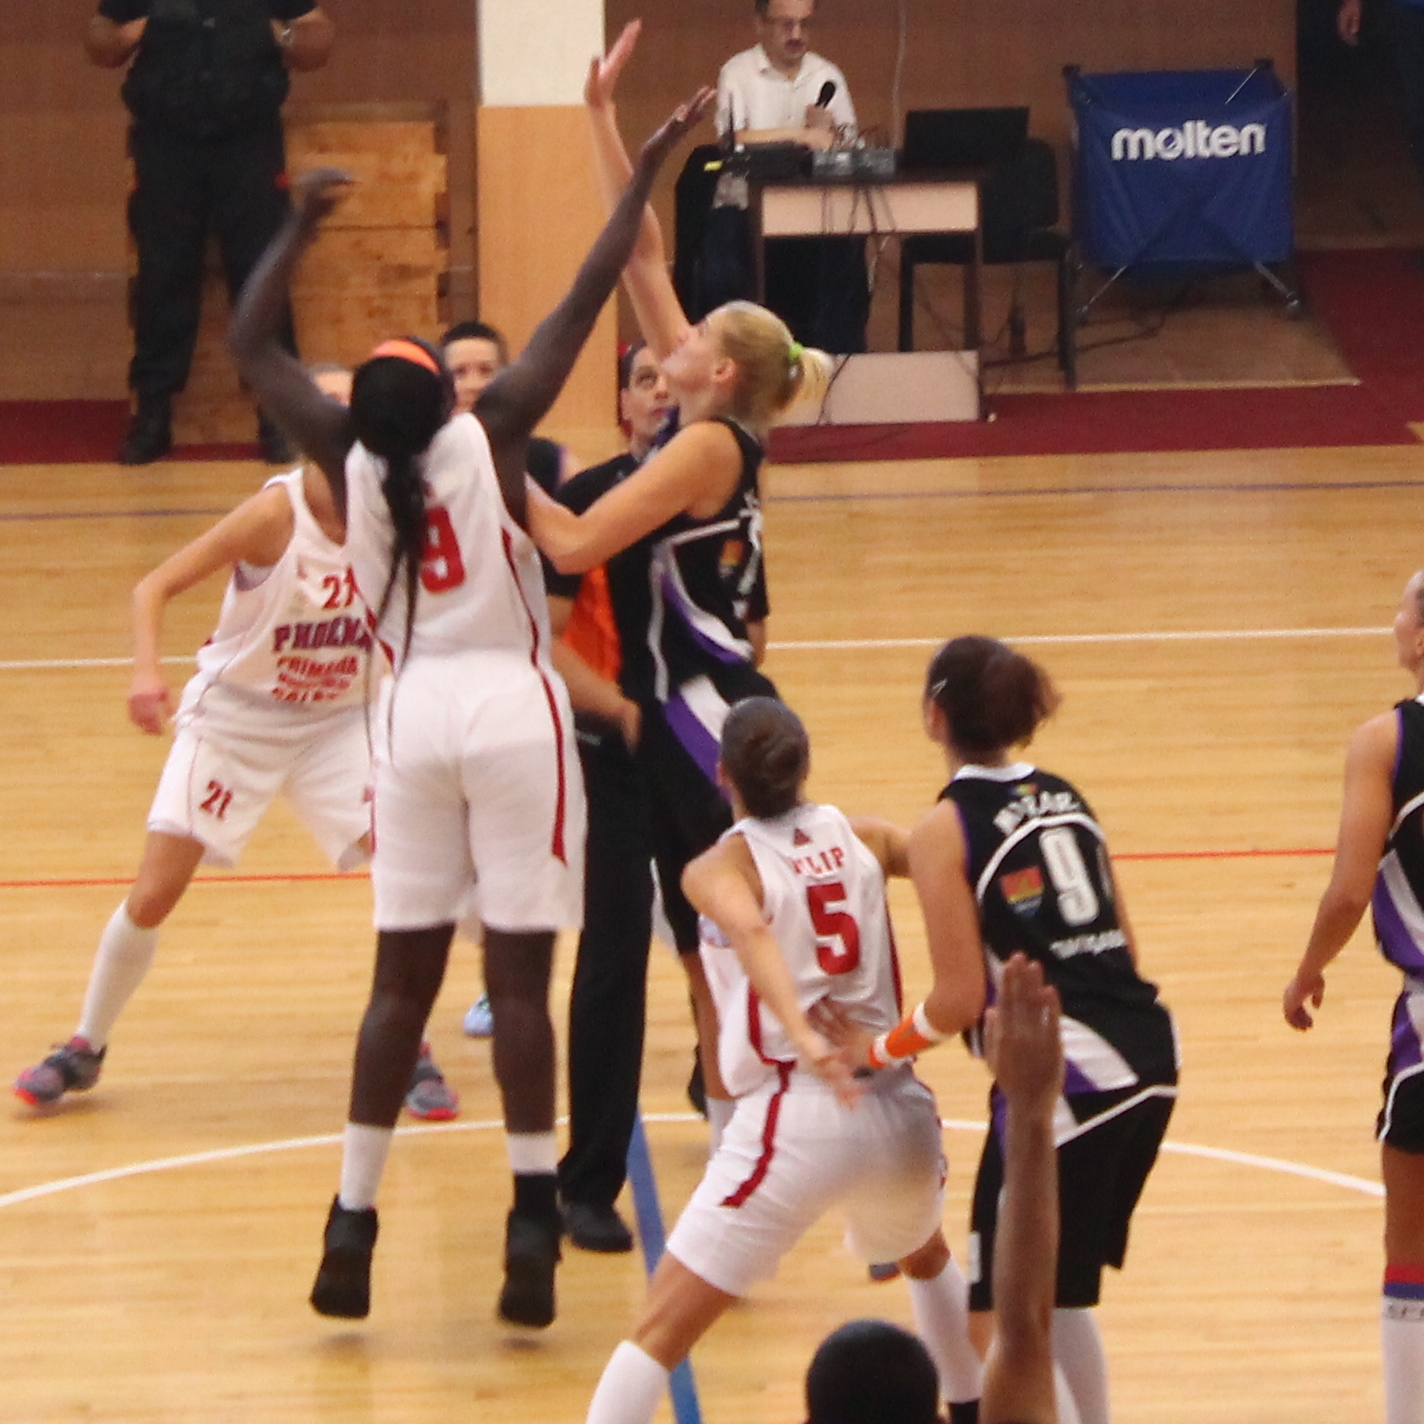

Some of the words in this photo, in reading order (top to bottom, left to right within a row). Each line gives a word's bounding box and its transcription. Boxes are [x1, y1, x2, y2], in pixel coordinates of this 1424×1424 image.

[1111, 120, 1267, 161] molten
[200, 779, 233, 820] 21
[1039, 827, 1100, 927] 9
[806, 881, 861, 975] 5
